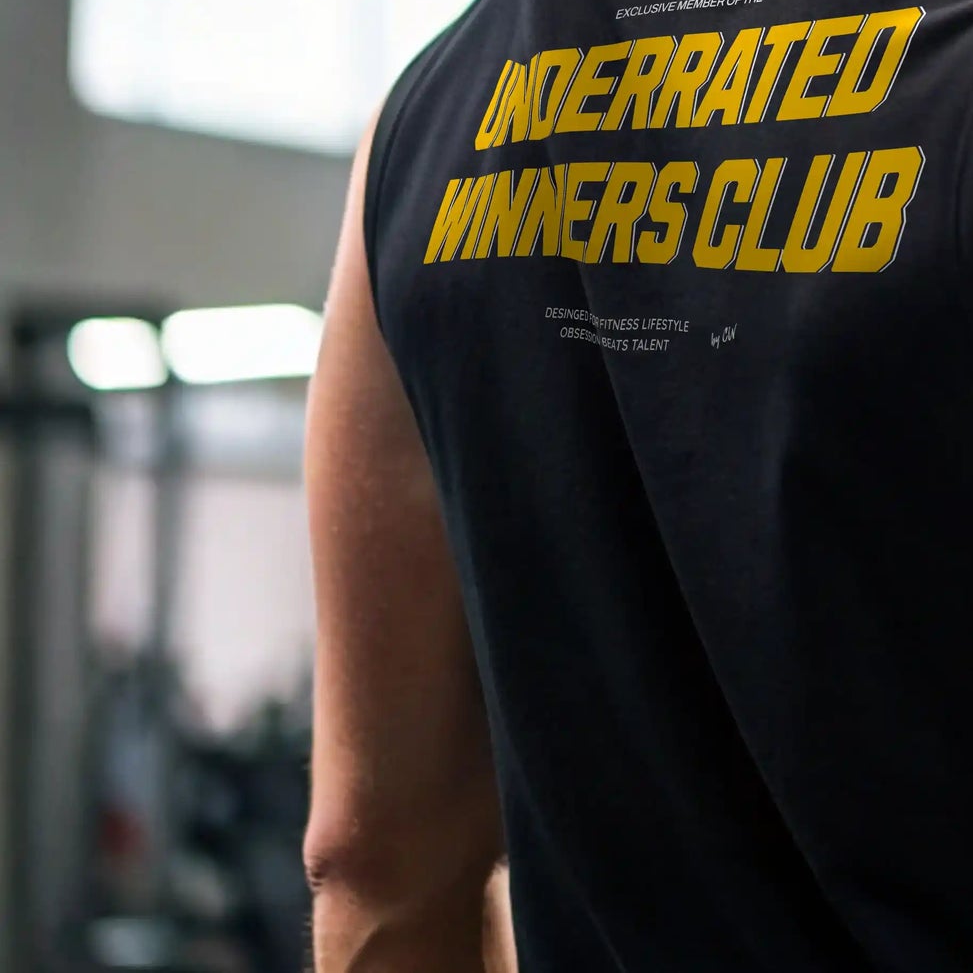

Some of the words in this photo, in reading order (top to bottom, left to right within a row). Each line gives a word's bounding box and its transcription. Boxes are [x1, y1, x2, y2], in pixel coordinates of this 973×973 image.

[615, 2, 677, 19] EXCLUSIVE
[474, 6, 927, 150] UNDERRATED
[423, 161, 700, 265] WINNERS
[692, 145, 926, 273] CLUB
[545, 307, 589, 322] DESINGED
[589, 313, 600, 326] FOR
[600, 318, 640, 331] FITNESS
[642, 318, 690, 333] LIFESTYLE
[560, 327, 600, 345] OBSESSION
[601, 338, 629, 351] BEATS
[632, 339, 670, 352] TALENT
[710, 332, 721, 349] by
